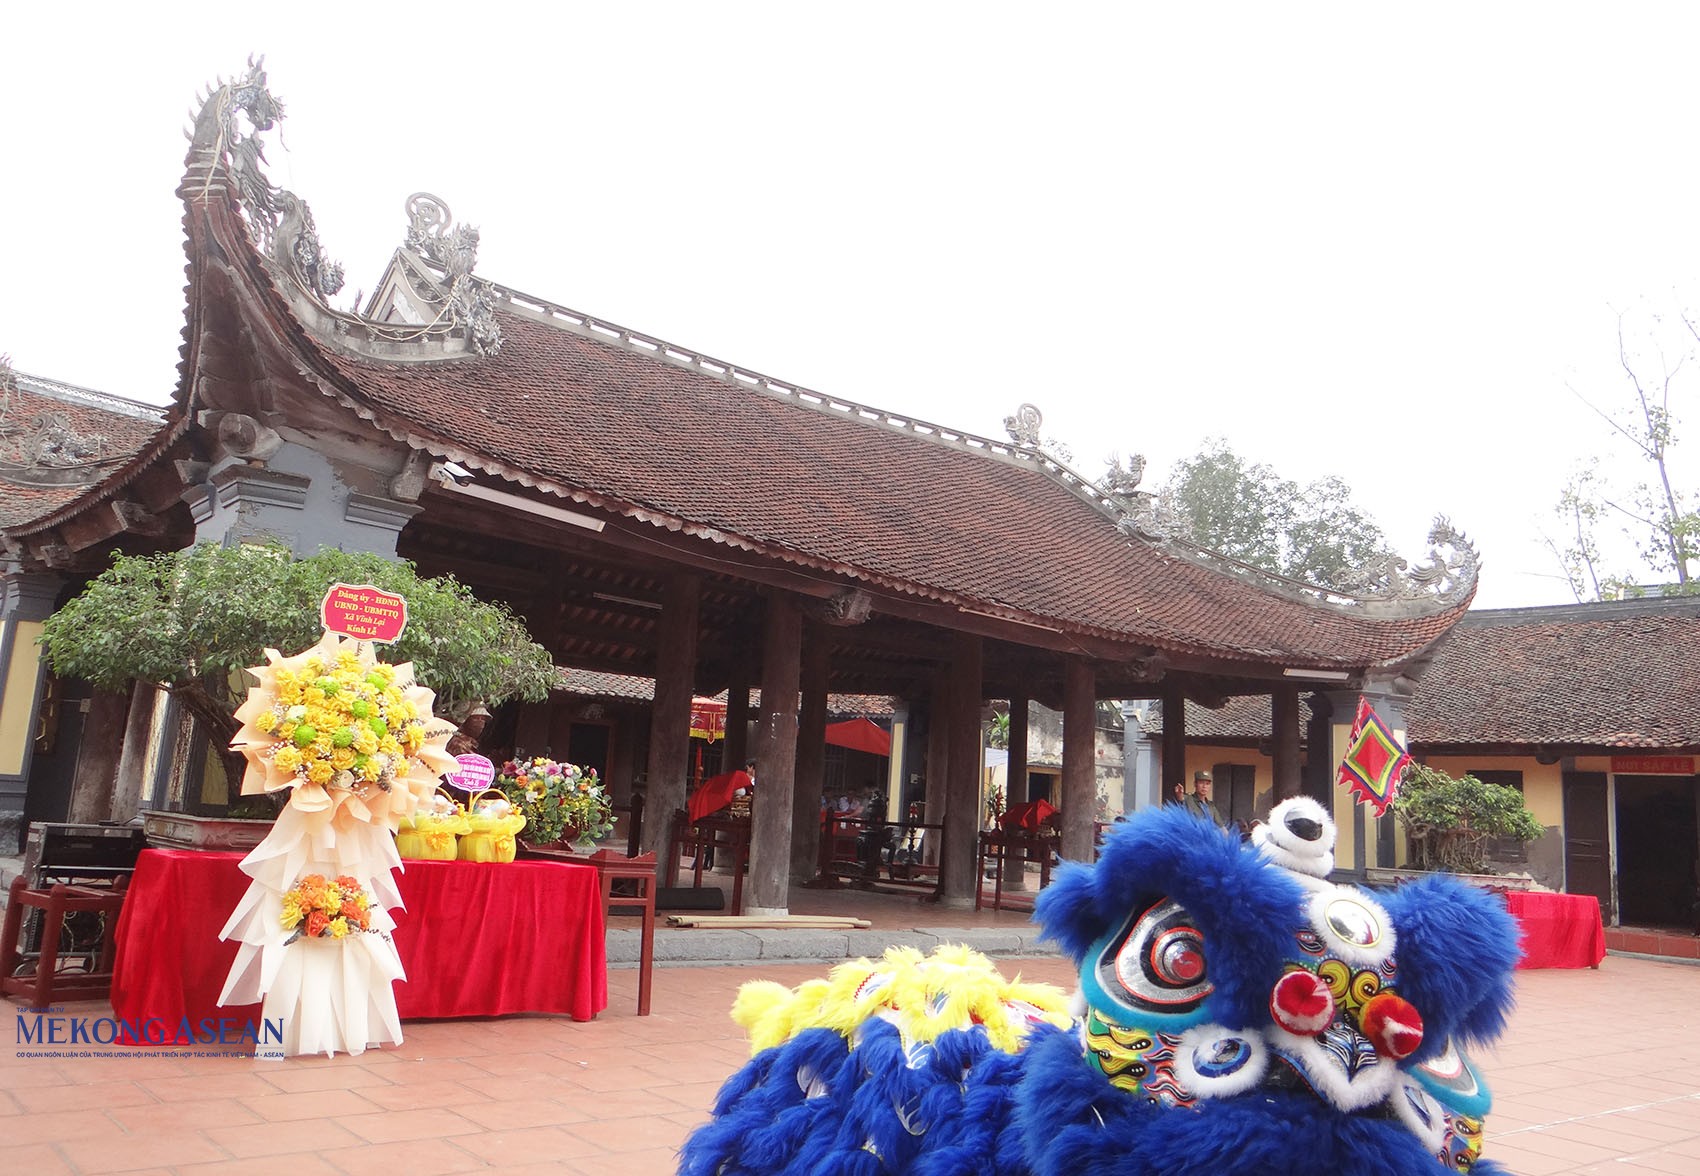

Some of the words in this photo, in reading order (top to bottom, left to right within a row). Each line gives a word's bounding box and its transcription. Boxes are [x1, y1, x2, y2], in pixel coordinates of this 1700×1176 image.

[375, 596, 399, 607] HĐND
[334, 600, 359, 611] UBND
[364, 605, 399, 619] UBMTTQ
[346, 624, 366, 633] Kính
